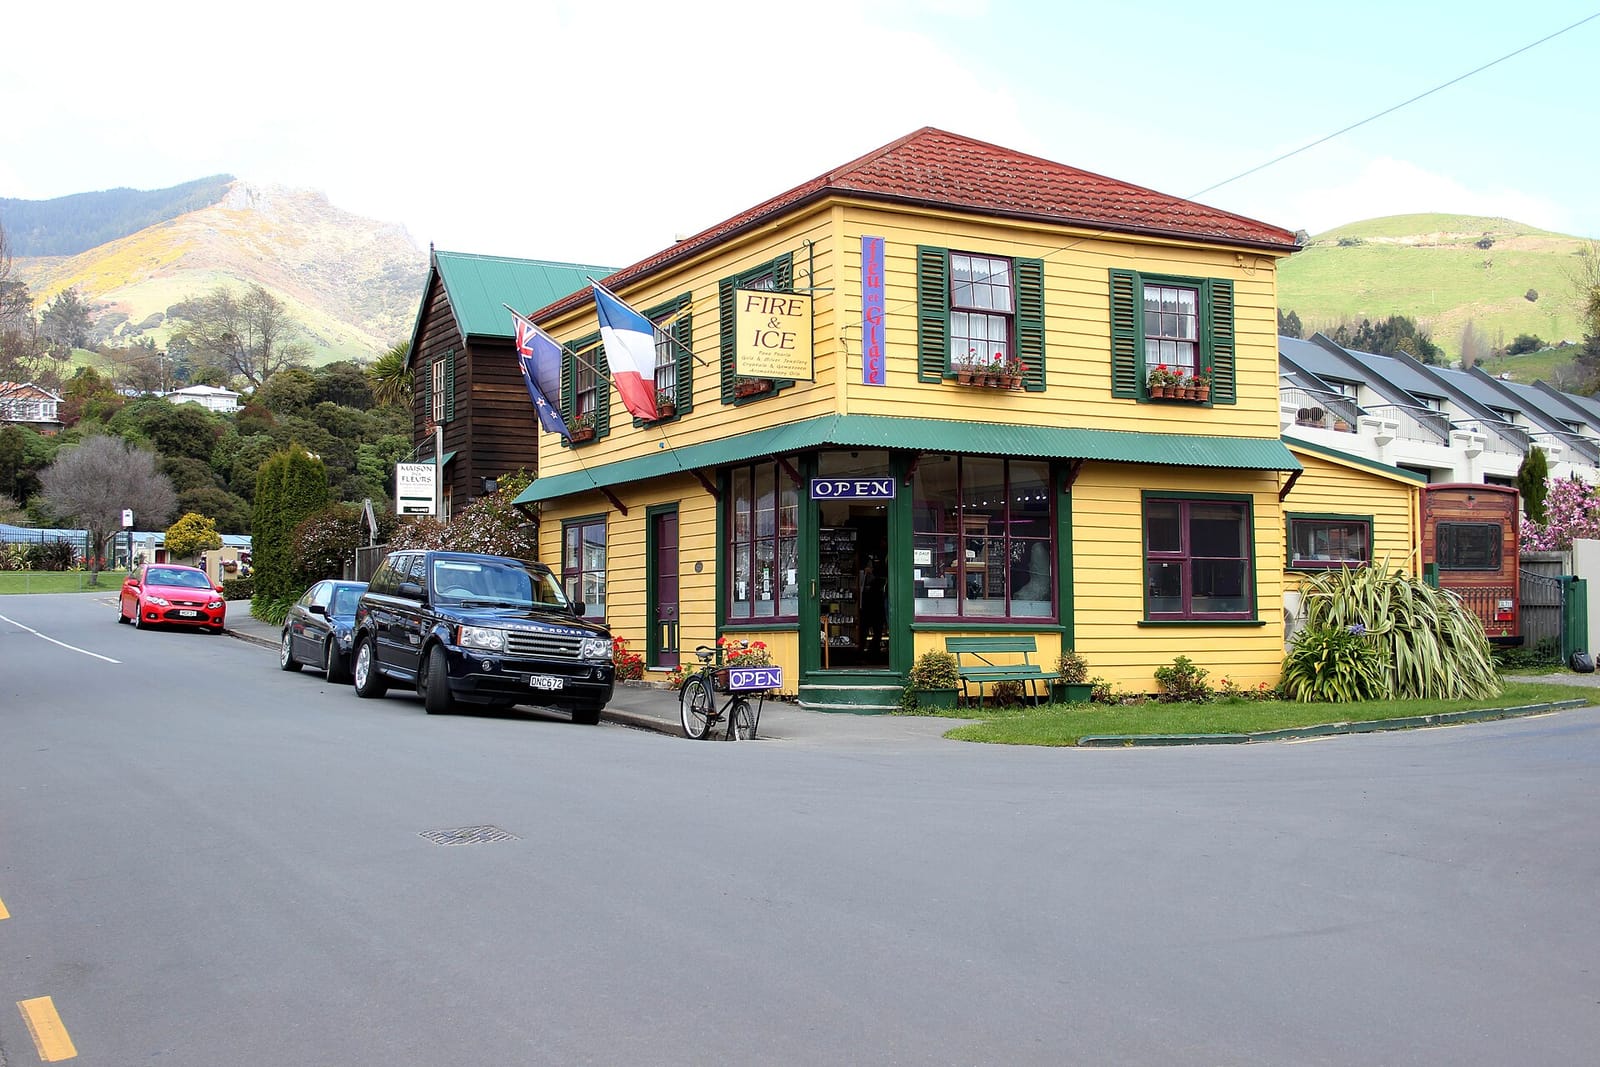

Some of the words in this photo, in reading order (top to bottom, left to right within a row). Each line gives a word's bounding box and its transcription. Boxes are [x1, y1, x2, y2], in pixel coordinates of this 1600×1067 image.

[867, 293, 879, 303] et
[744, 295, 804, 317] FIRE
[767, 316, 781, 329] &
[752, 329, 797, 350] ICE
[866, 306, 883, 384] Glace
[401, 475, 432, 483] FLEURS
[815, 481, 889, 496] OPEN
[507, 624, 543, 632] RANGE
[549, 627, 582, 635] ROVER
[530, 676, 563, 688] DNC672
[731, 671, 781, 687] OPEN
